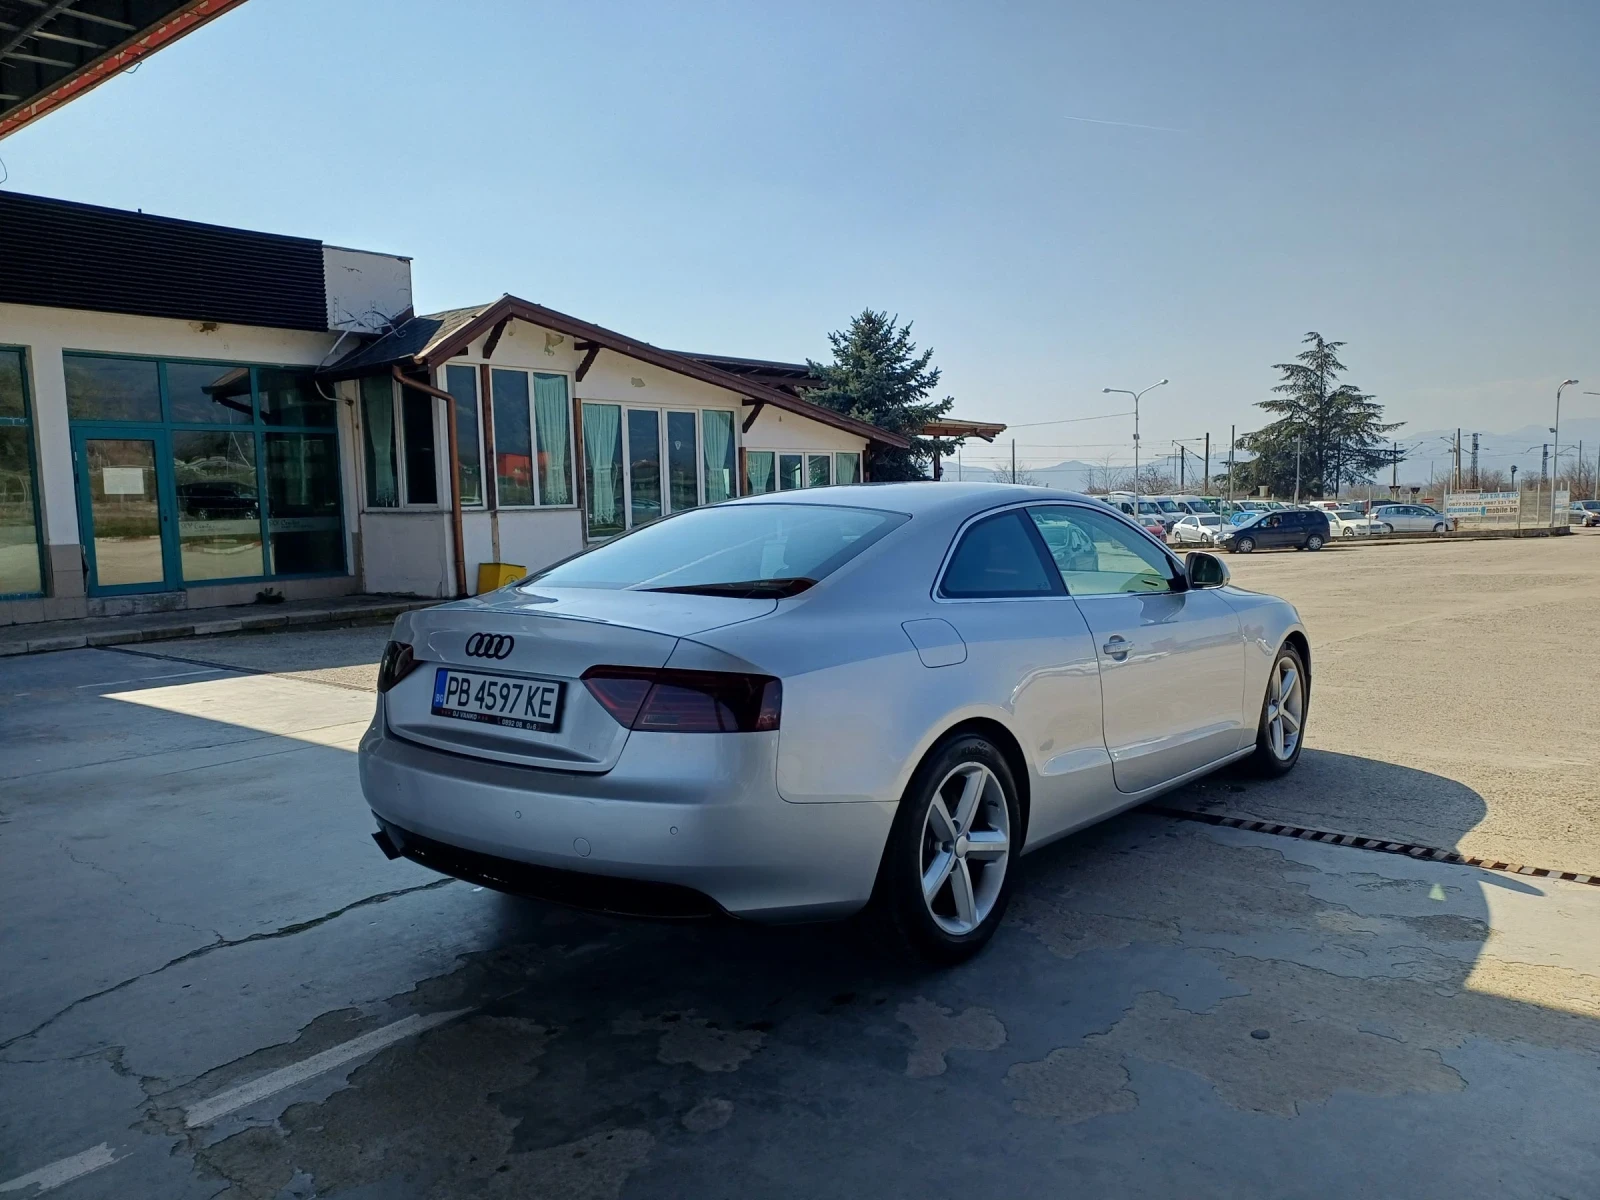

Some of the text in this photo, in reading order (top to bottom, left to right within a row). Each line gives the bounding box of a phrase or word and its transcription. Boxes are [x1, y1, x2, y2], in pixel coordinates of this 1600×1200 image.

[445, 676, 555, 719] PB 4597 KE
[460, 712, 478, 720] VANKO
